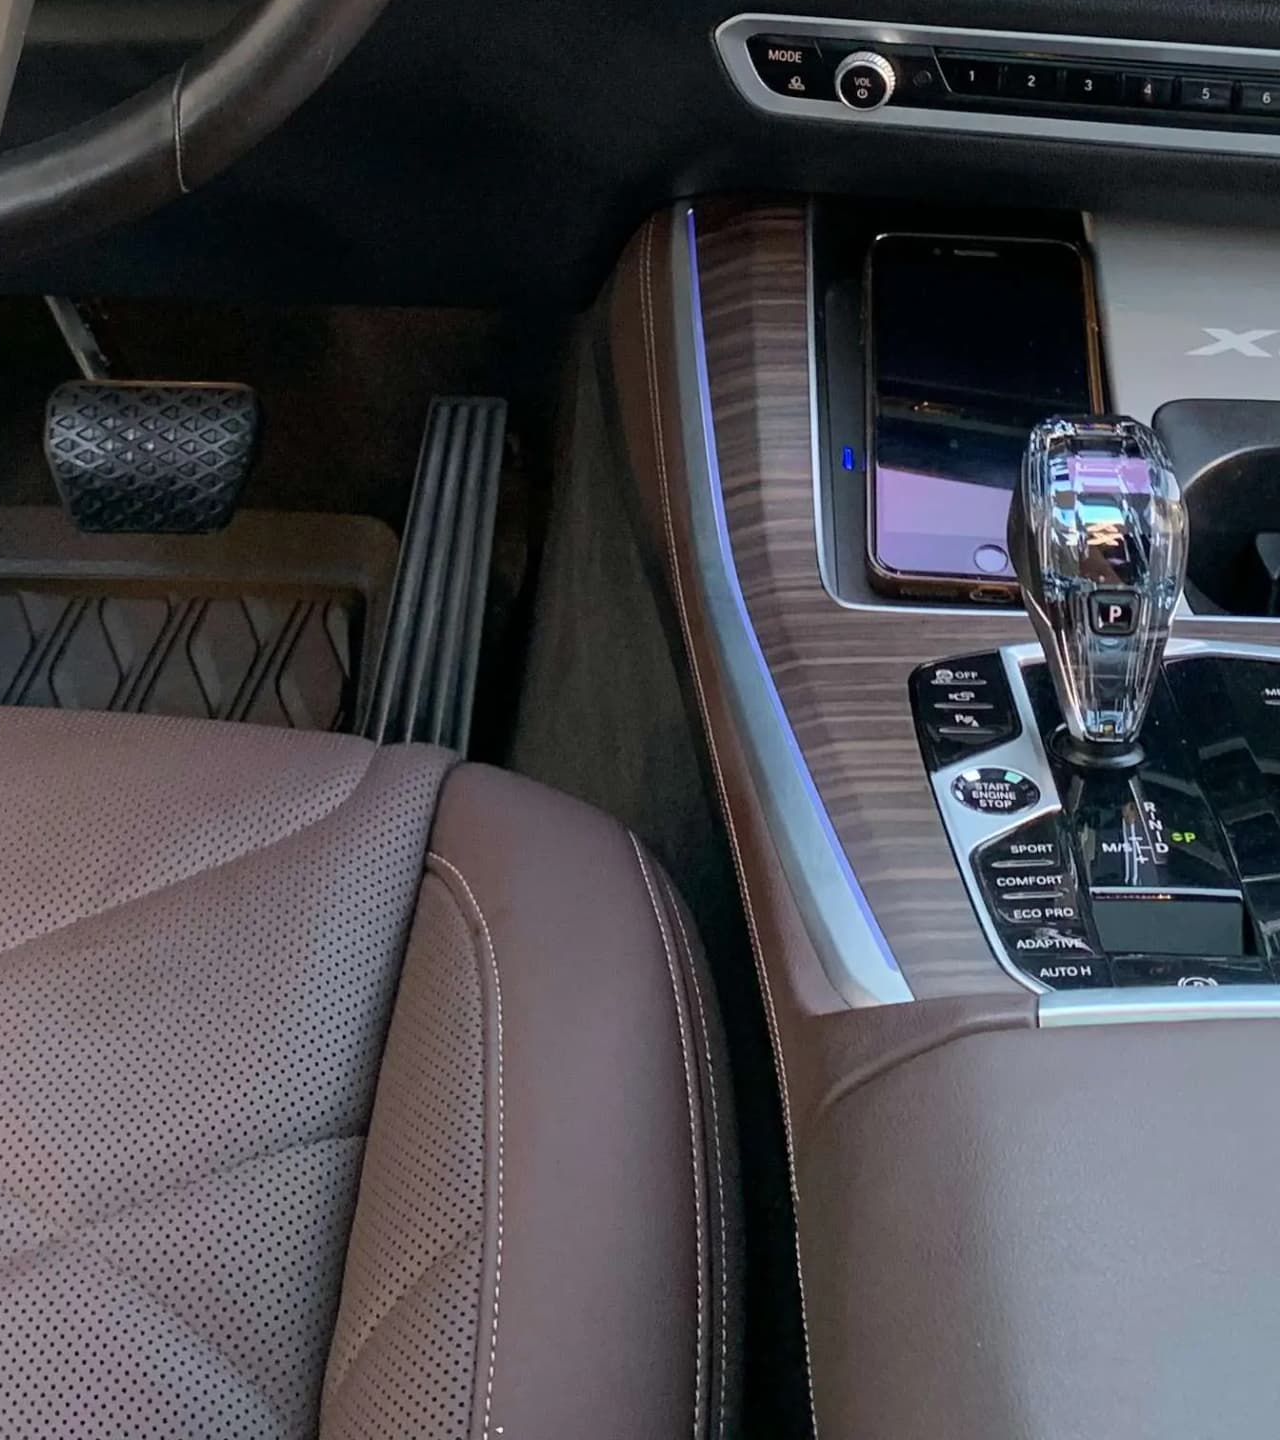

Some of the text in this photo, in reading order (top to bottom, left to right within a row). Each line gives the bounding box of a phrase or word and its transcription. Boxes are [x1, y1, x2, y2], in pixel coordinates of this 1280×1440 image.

[768, 48, 803, 64] MODE
[854, 76, 872, 88] VOL
[968, 70, 975, 82] 1
[1027, 74, 1036, 88] 2
[1084, 79, 1093, 92] 3
[1143, 83, 1152, 96] 4
[1201, 87, 1210, 100] 5
[1262, 91, 1271, 104] 6
[1108, 605, 1122, 622] P
[954, 671, 978, 679] OFF
[975, 782, 1011, 791] START
[971, 791, 1016, 800] ENGINE
[979, 800, 1012, 808] STOP
[1143, 802, 1156, 812] R
[1148, 820, 1163, 830] N
[1010, 844, 1053, 855] SPORT
[1155, 843, 1169, 853] D
[996, 876, 1063, 887] COMFORT
[1013, 908, 1074, 920] ECO PRO
[1016, 939, 1084, 950] ADAPTIVE
[1039, 966, 1092, 978] AUTO H
